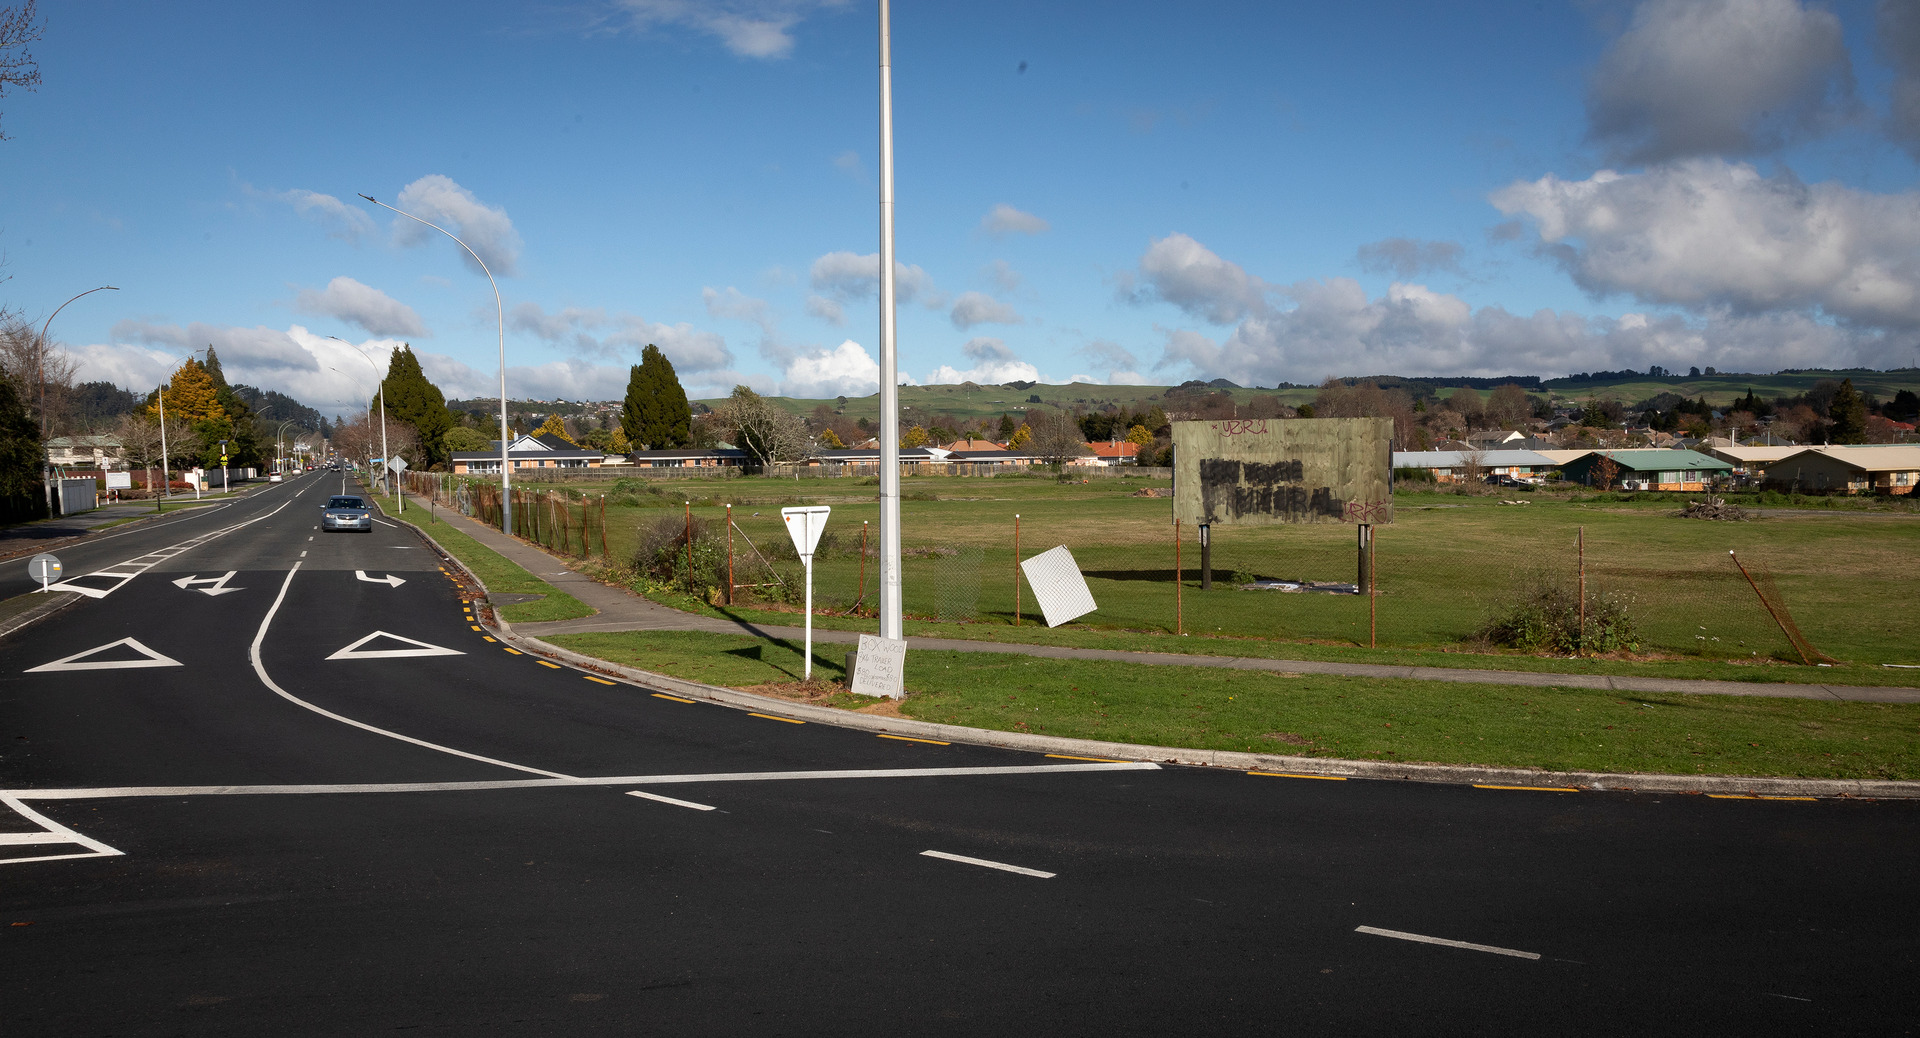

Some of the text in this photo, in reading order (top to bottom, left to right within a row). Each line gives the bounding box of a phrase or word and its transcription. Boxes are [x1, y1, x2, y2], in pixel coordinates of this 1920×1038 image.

[861, 636, 882, 653] BOX
[874, 664, 893, 673] LOAD
[859, 676, 891, 690] DELIVERED
